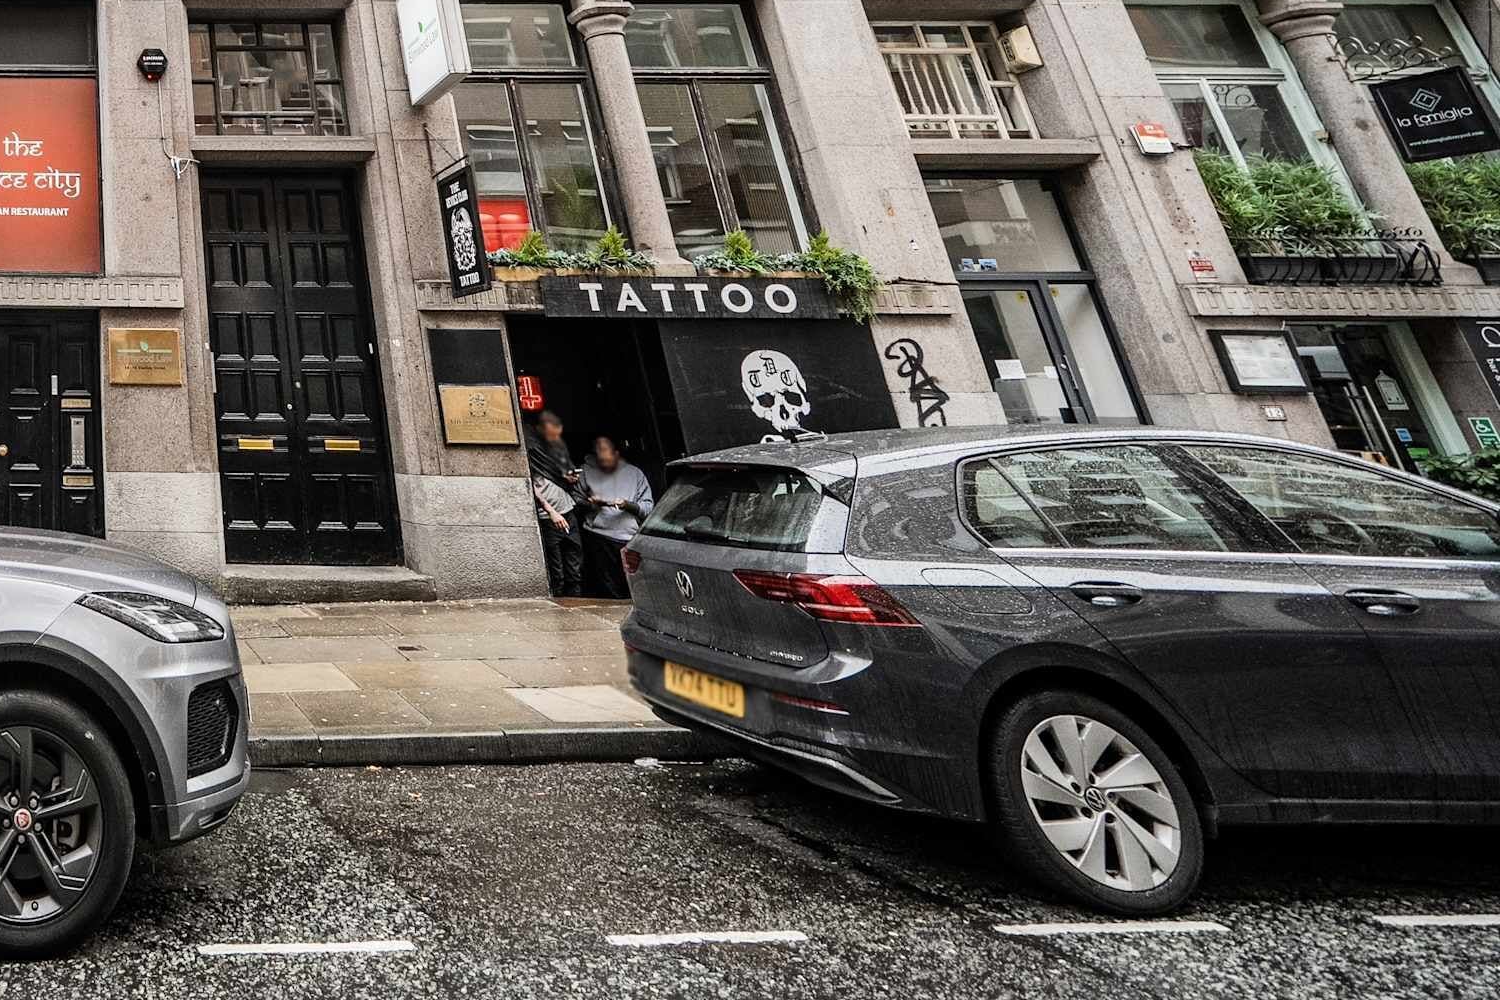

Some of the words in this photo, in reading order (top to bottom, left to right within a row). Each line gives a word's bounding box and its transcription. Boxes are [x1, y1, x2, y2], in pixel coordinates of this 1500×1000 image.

[1413, 106, 1474, 128] famiglia
[2, 131, 44, 157] the
[33, 166, 81, 198] city
[11, 207, 70, 217] RESTAURANT
[578, 282, 798, 314] TATTOO
[680, 604, 705, 616] GOLF
